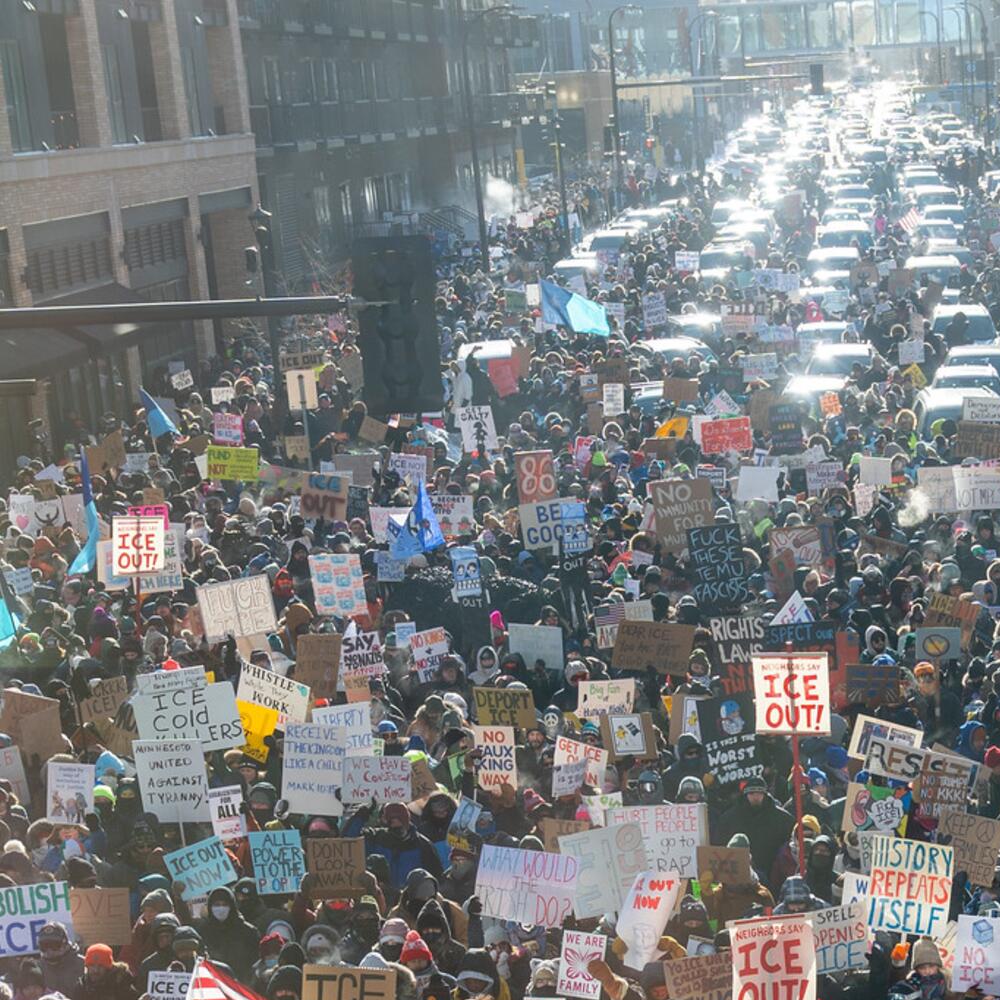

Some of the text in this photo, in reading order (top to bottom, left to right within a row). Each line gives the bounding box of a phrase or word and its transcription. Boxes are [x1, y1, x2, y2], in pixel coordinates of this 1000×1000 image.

[521, 456, 555, 495] 86
[537, 504, 561, 523] BE
[118, 533, 156, 550] ICE
[690, 529, 739, 547] FUCK
[117, 552, 158, 570] OUT!
[692, 547, 737, 565] THESE
[697, 562, 744, 582] TEMU
[693, 581, 748, 602] FASCISTS
[710, 617, 764, 641] RIGHTS
[764, 674, 819, 700] ICE
[475, 690, 529, 708] DEPORT
[489, 708, 519, 725] ICE
[766, 703, 823, 730] OUT!
[483, 731, 505, 743] NO
[476, 745, 513, 758] FAUX
[476, 759, 514, 771] KING
[482, 773, 510, 786] WAY
[170, 842, 225, 873] ICE OUT
[874, 836, 952, 876] HISTORY
[186, 862, 230, 893] NOW!
[870, 870, 949, 905] REPEATS
[868, 897, 944, 935] ITSELF
[735, 925, 804, 940] NEIGHBORS SAY
[738, 939, 803, 977] ICE
[964, 947, 985, 962] NO
[960, 965, 994, 984] ICE
